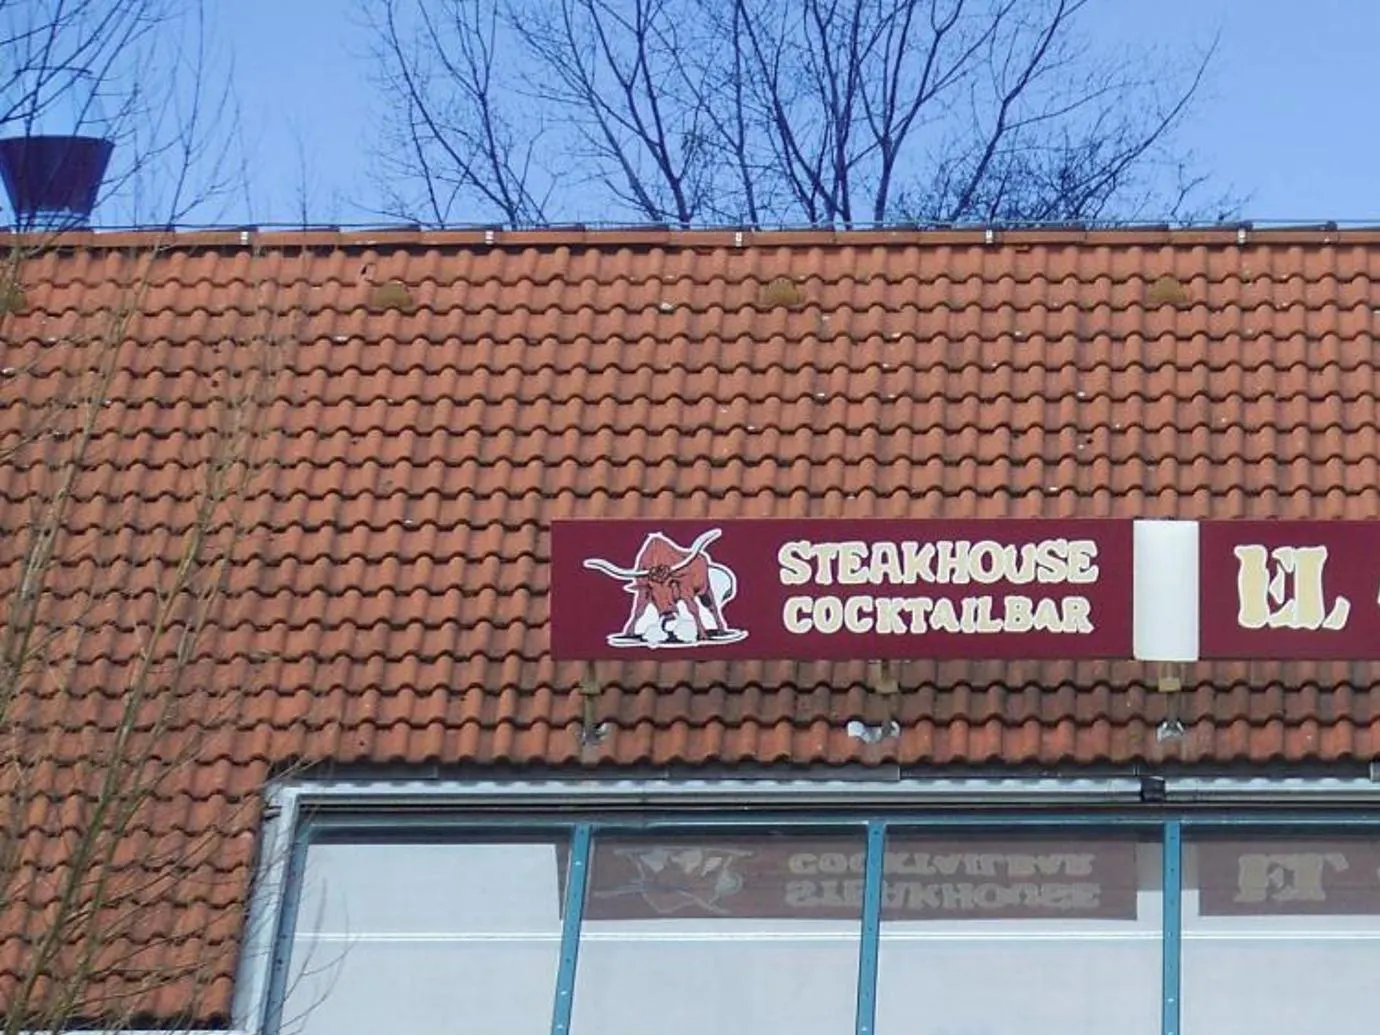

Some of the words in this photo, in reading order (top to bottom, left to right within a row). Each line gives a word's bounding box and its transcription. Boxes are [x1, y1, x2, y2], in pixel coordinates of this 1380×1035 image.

[778, 540, 1099, 586] STEAKHOUSE
[1234, 545, 1350, 630] EL
[782, 596, 1095, 635] COCKTAILBAR
